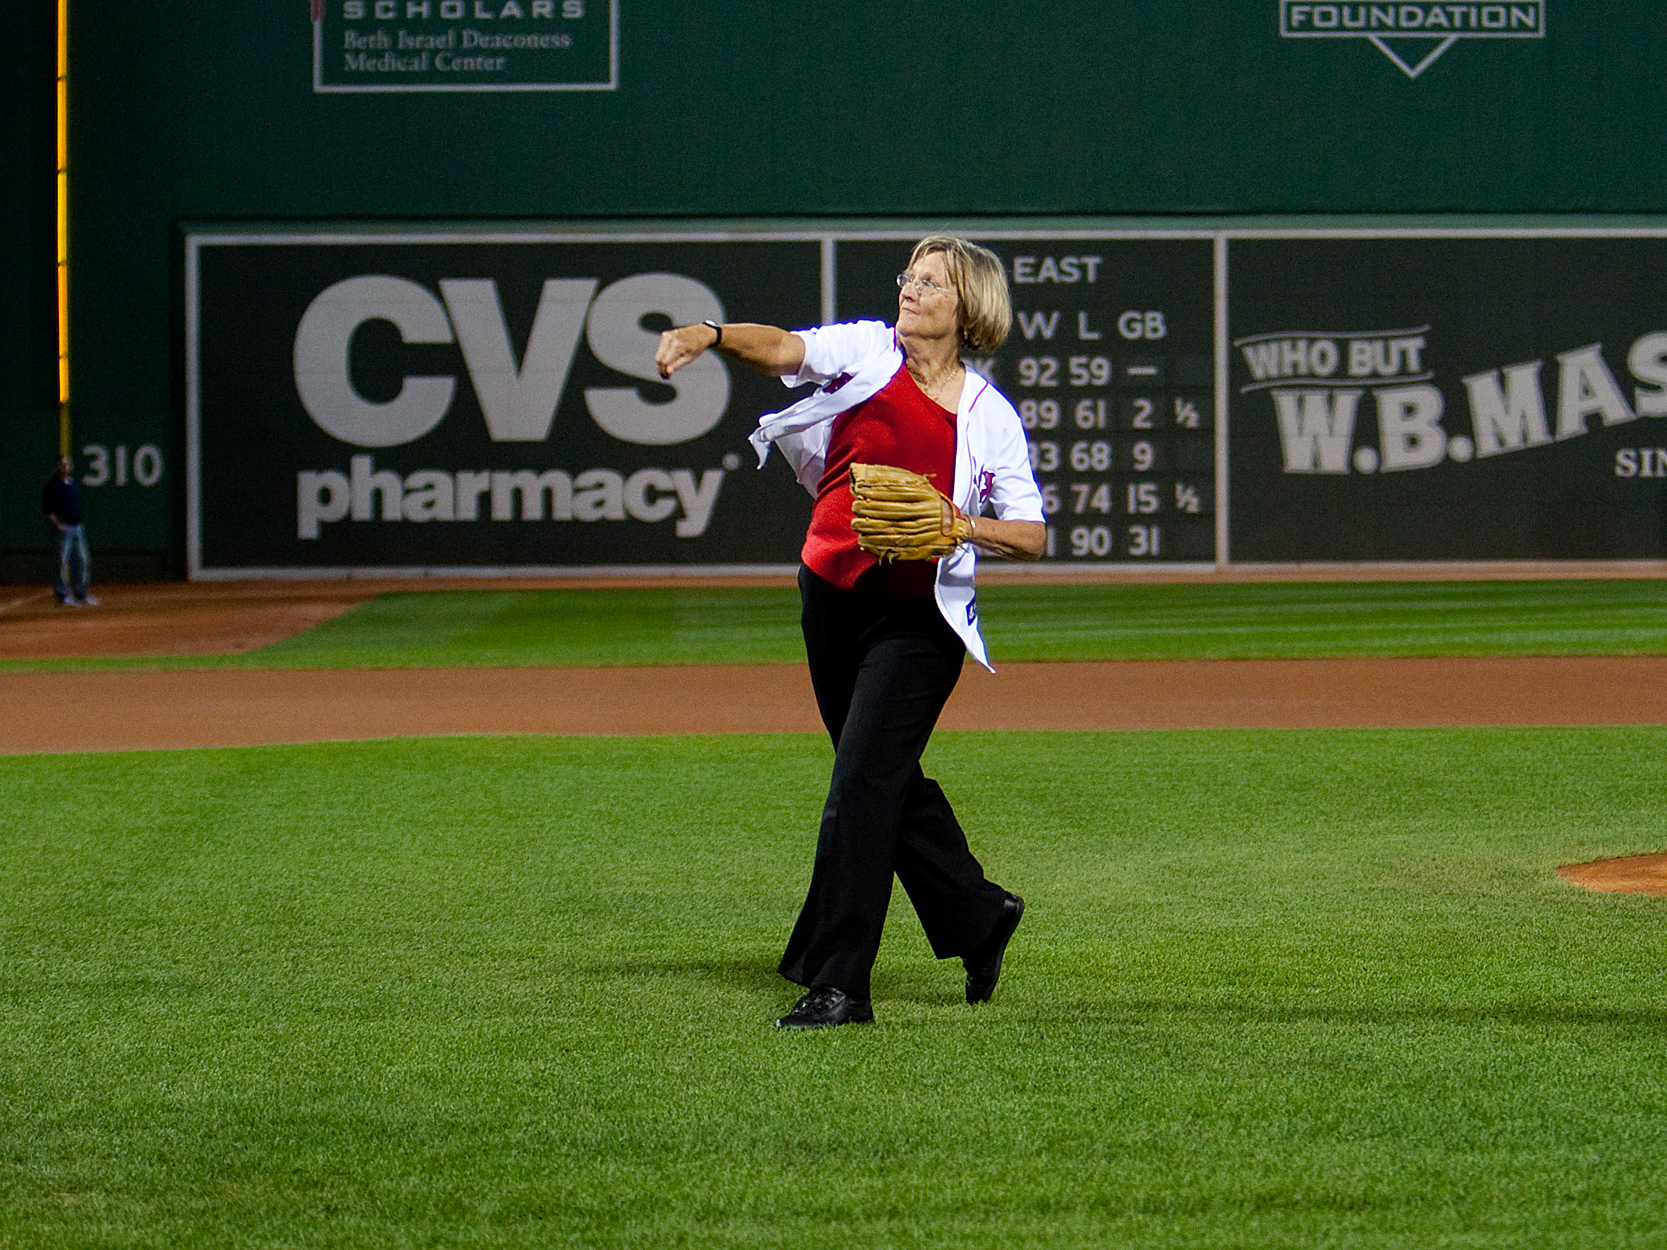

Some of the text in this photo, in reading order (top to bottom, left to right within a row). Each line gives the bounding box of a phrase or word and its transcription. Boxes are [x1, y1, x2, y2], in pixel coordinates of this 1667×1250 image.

[343, 0, 585, 20] SCHOLARS
[1290, 5, 1537, 29] FOUNDATION
[343, 29, 574, 50] Beth Israel Deaconess
[343, 52, 506, 72] Medical Center
[1013, 256, 1103, 283] EAST
[1018, 311, 1168, 341] W L GB
[293, 272, 731, 448] CVS
[1018, 357, 1061, 387] 92
[1068, 357, 1112, 387] 59
[1242, 335, 1426, 381] WHO BUT
[1020, 400, 1061, 430] 89
[1075, 400, 1107, 430] 61
[1132, 400, 1154, 430] 2
[82, 444, 164, 487] 310
[1070, 441, 1113, 472] 68
[1132, 441, 1154, 472] 9
[297, 455, 724, 539] pharmacy
[1070, 484, 1113, 514] 74
[1127, 484, 1161, 514] 15
[1070, 525, 1113, 556] 90
[1128, 525, 1161, 556] 31
